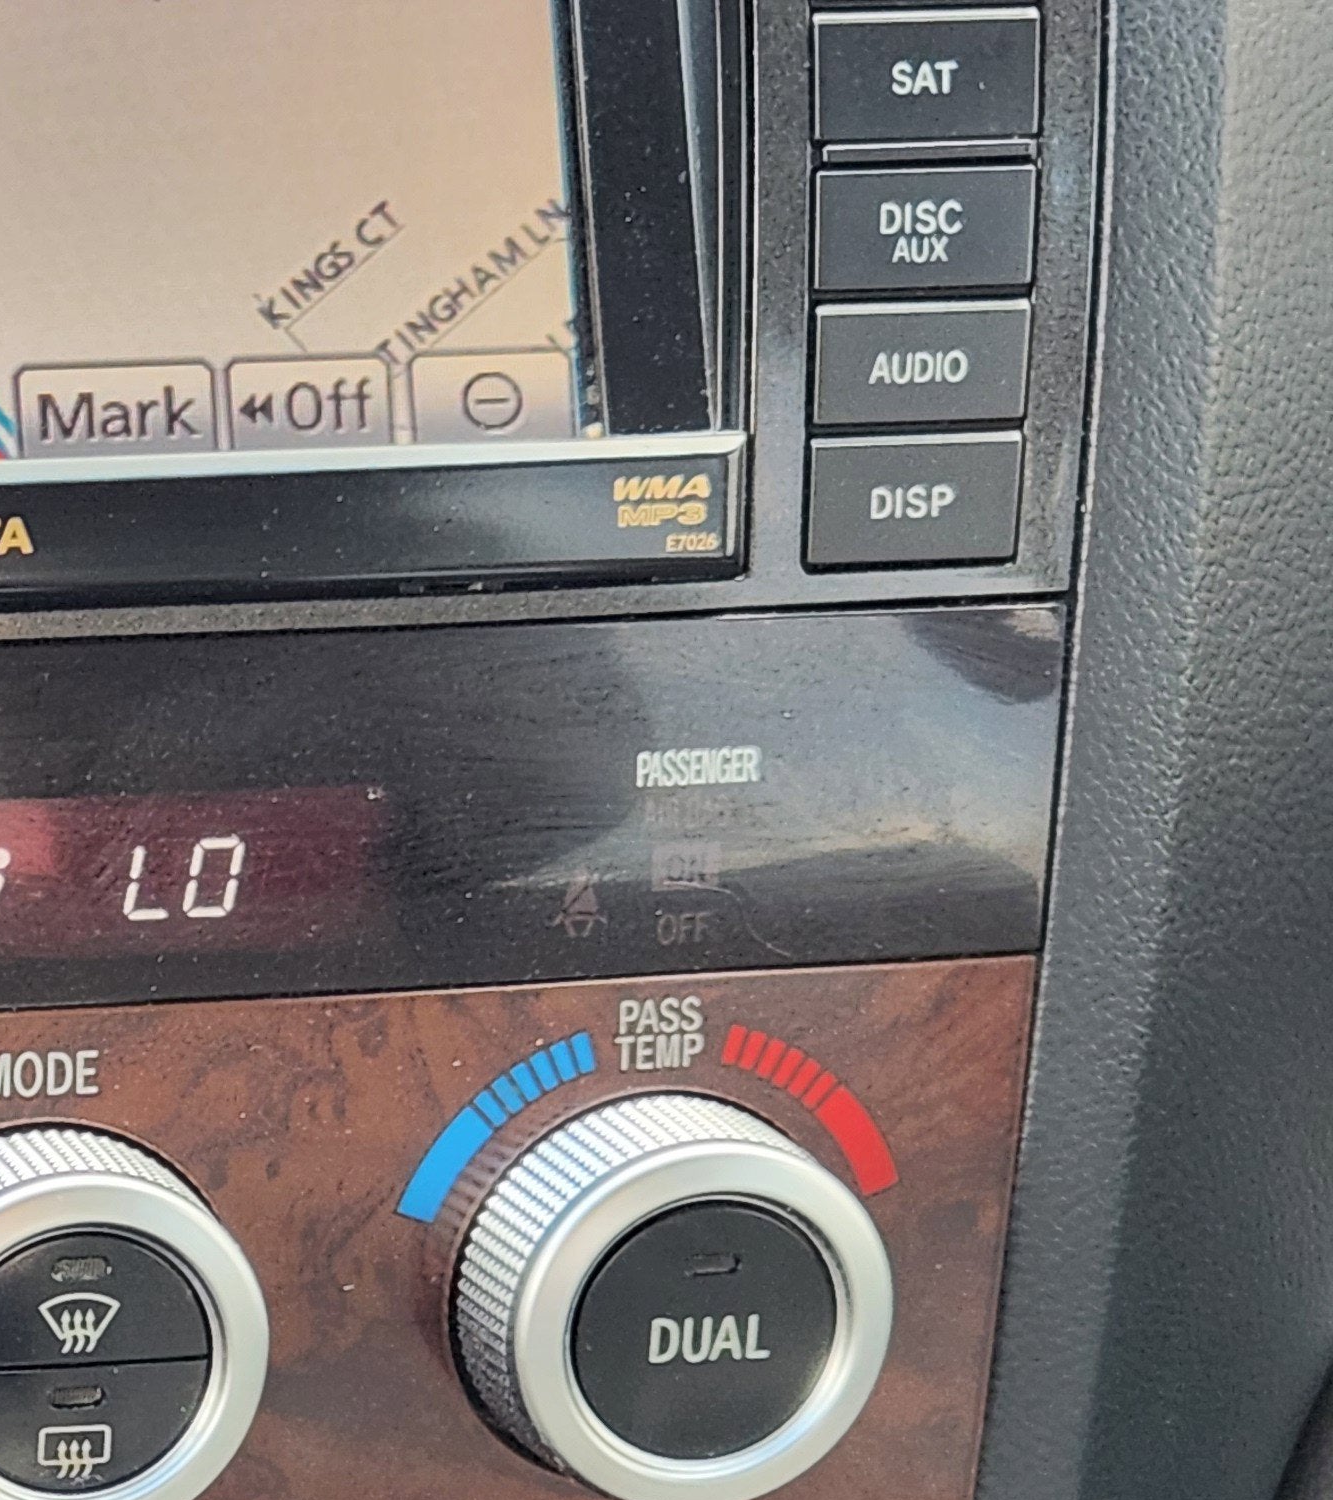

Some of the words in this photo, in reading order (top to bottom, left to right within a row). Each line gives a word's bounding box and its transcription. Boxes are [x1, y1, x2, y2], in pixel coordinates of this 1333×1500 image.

[890, 59, 959, 96] SAT
[878, 199, 964, 237] DISC
[256, 240, 356, 332] KINGS
[355, 200, 404, 253] CT
[891, 235, 950, 264] AUX
[868, 349, 969, 386] AUDIO
[38, 385, 197, 440] Mark
[284, 376, 375, 431] Off
[612, 472, 712, 502] WMA
[869, 483, 955, 520] DISP
[616, 500, 709, 529] MP3
[664, 532, 719, 553] E7026
[635, 746, 762, 788] PASSENGER
[617, 996, 704, 1035] PASS
[613, 1033, 705, 1071] TEMP
[647, 1313, 772, 1366] DUAL
